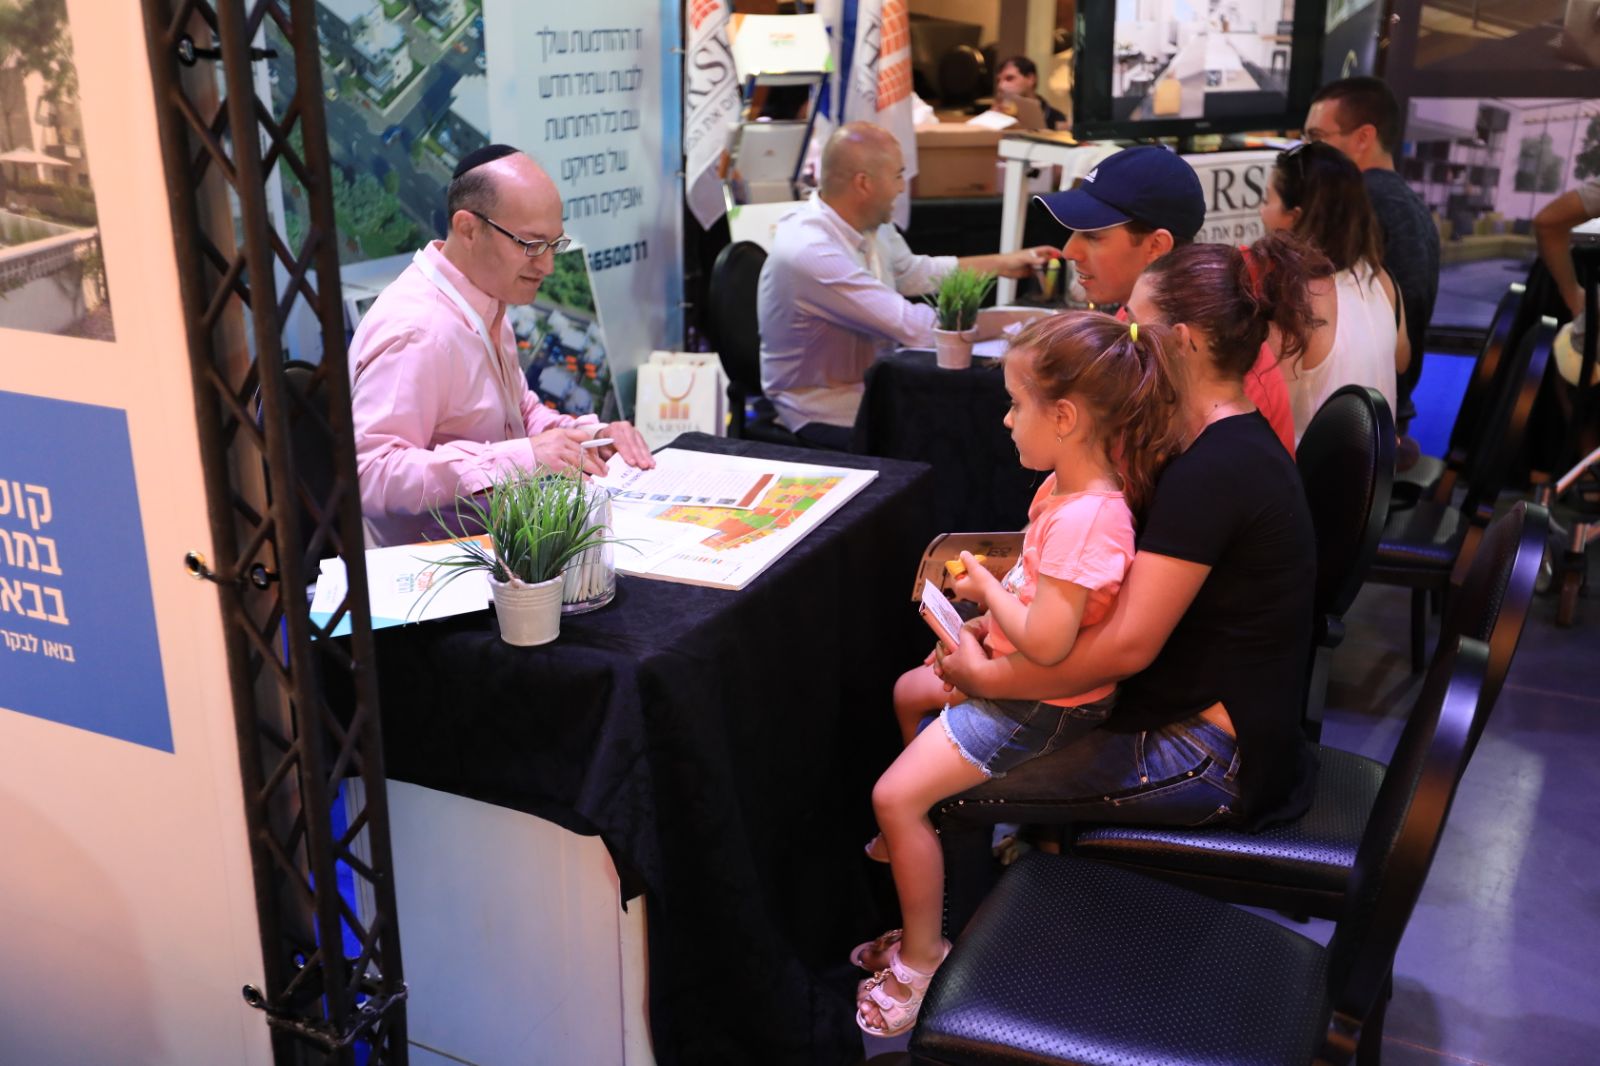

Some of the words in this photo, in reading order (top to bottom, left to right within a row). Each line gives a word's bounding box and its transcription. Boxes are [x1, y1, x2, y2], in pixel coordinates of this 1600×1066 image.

[1210, 165, 1265, 212] RS
[0, 577, 70, 626] בבא
[0, 629, 39, 654] לבקר
[42, 639, 76, 663] בואו
